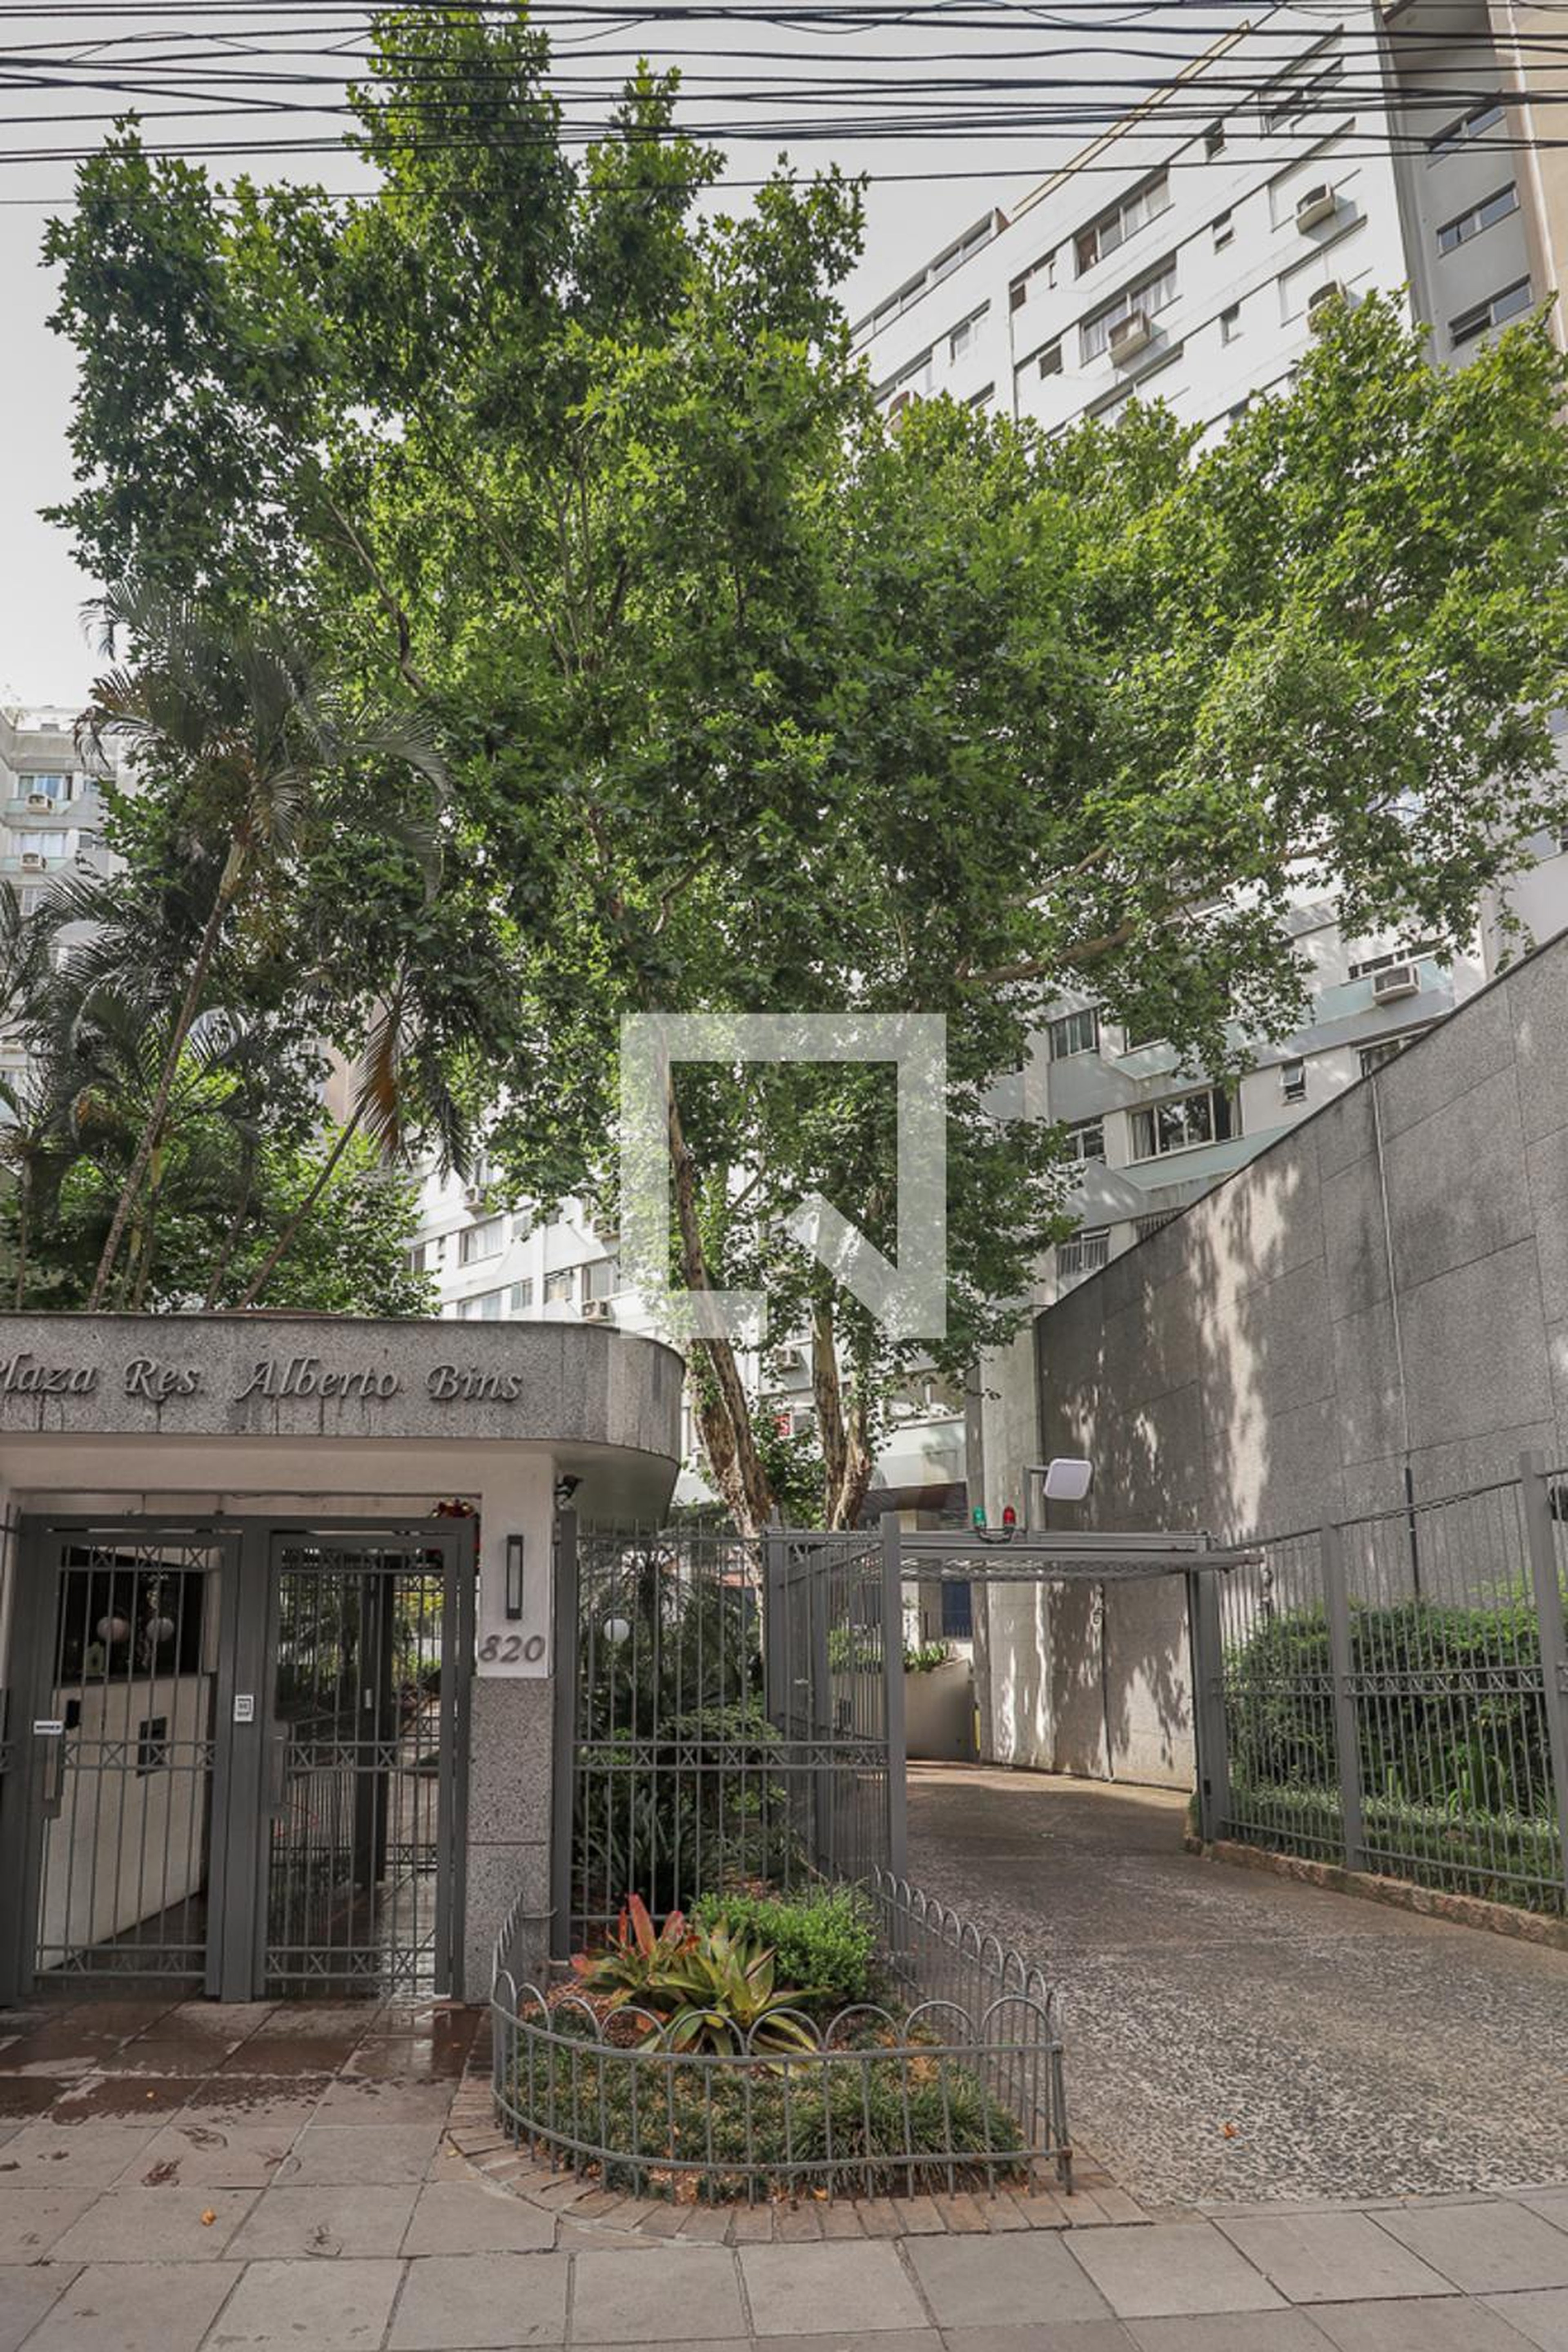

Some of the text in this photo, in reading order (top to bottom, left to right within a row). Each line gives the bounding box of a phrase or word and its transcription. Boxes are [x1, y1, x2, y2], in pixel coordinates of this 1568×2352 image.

[124, 1356, 200, 1401] Res
[234, 1358, 399, 1402] Alberto
[425, 1365, 523, 1402] Bins
[479, 1635, 546, 1663] 820
